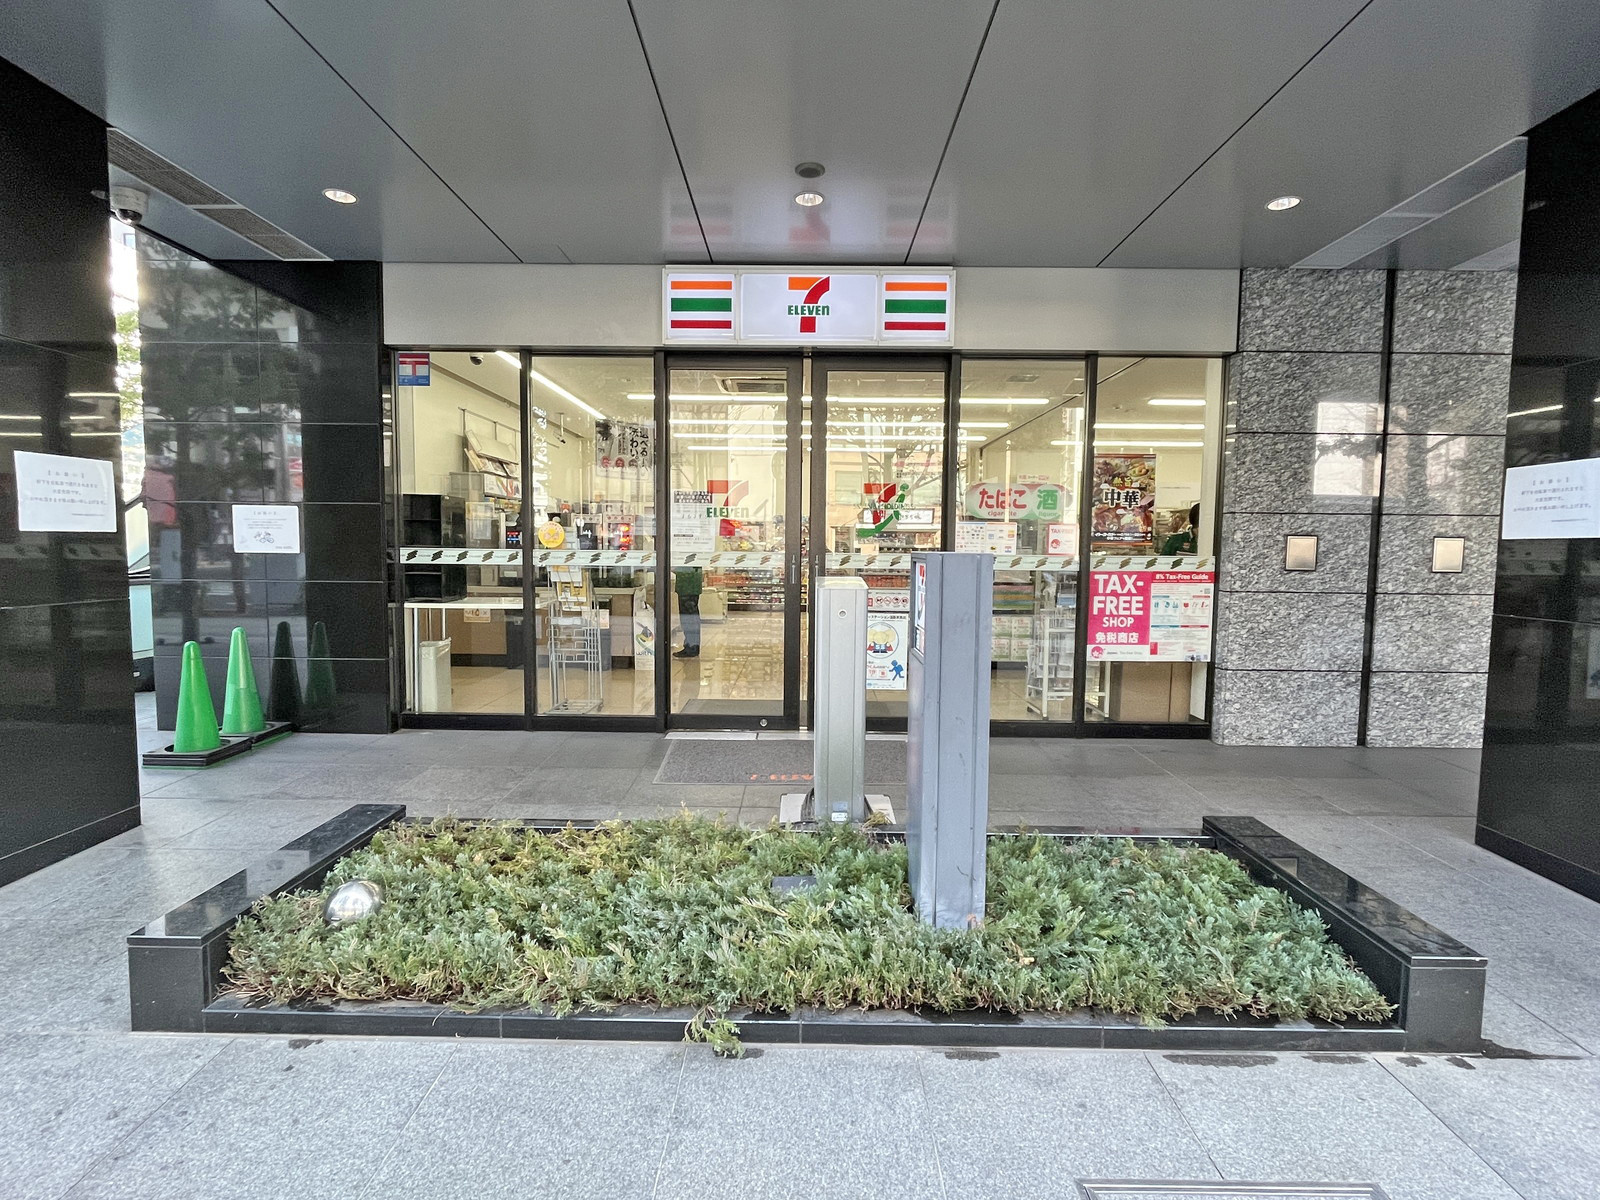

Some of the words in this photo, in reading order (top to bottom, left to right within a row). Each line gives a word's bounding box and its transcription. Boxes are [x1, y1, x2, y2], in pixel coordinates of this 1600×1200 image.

[788, 276, 830, 332] 7
[978, 488, 1027, 509] たばこ
[1037, 489, 1058, 510] 酒
[1104, 488, 1140, 508] 中華
[1094, 574, 1144, 594] TAX-
[1093, 596, 1144, 616] FREE
[1102, 616, 1135, 628] SHOP
[1095, 632, 1139, 644] 免税商店
